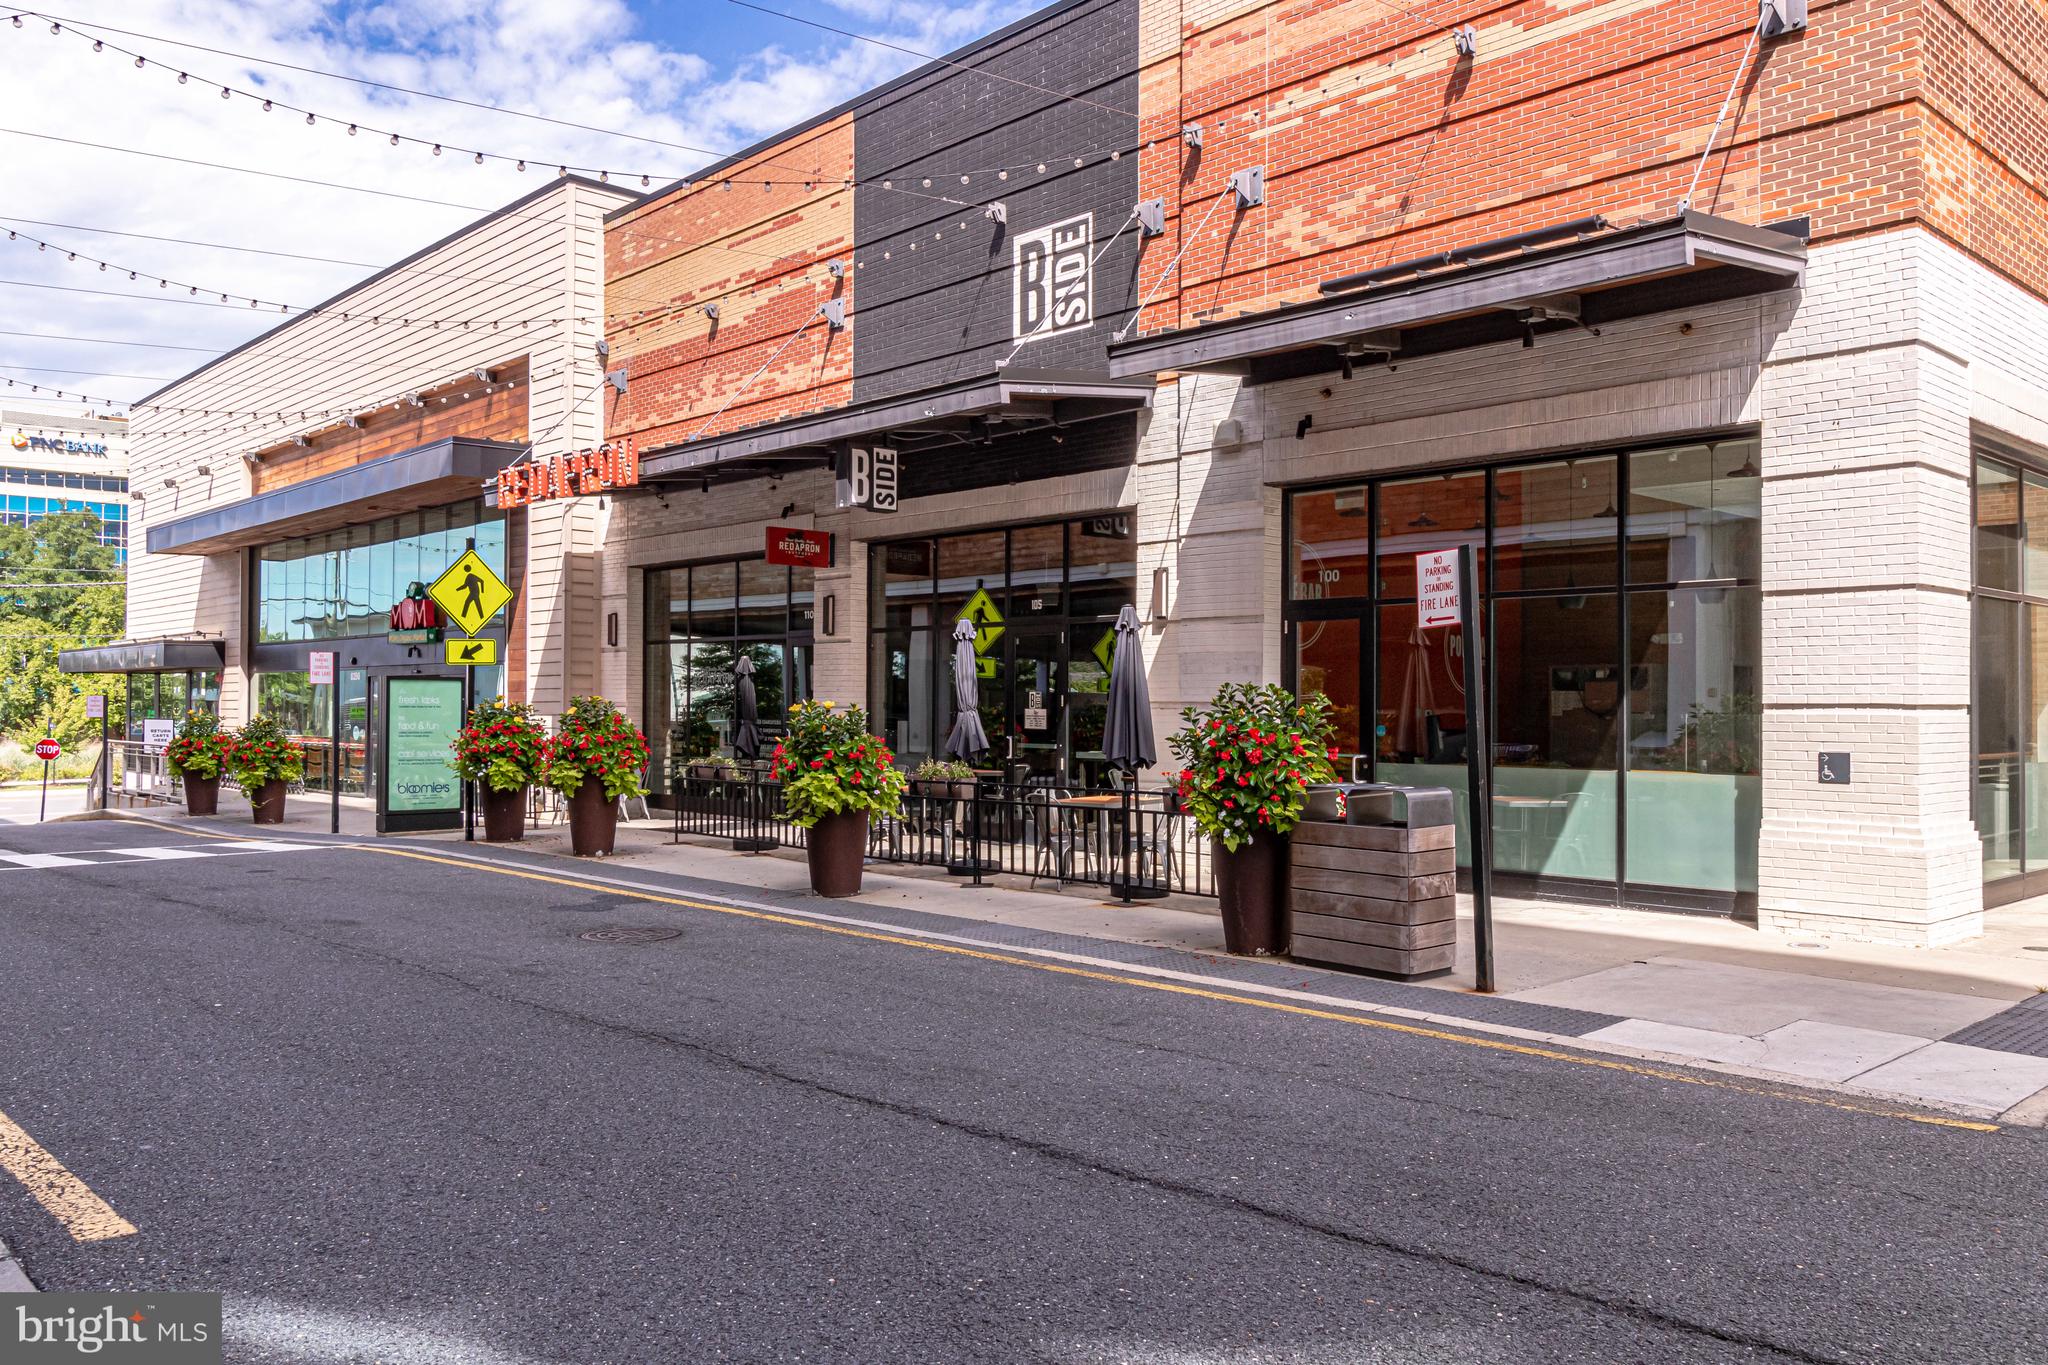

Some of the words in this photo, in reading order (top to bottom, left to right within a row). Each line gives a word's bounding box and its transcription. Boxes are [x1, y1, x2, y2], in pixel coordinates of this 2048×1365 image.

[1020, 240, 1046, 337] B
[1055, 224, 1086, 326] SIDE
[30, 436, 65, 452] PNC
[66, 439, 108, 455] BANK
[851, 448, 870, 504] B
[875, 451, 896, 507] SIDE
[1433, 555, 1443, 565] NO
[1318, 569, 1340, 583] 100
[1425, 565, 1452, 577] PARKING
[1424, 581, 1454, 594] STANDING
[1031, 599, 1043, 610] 105
[1420, 598, 1437, 611] FIRE
[1439, 595, 1459, 609] LANE
[804, 610, 814, 620] 110
[36, 744, 59, 754] STOP
[397, 781, 450, 794] bloomie's
